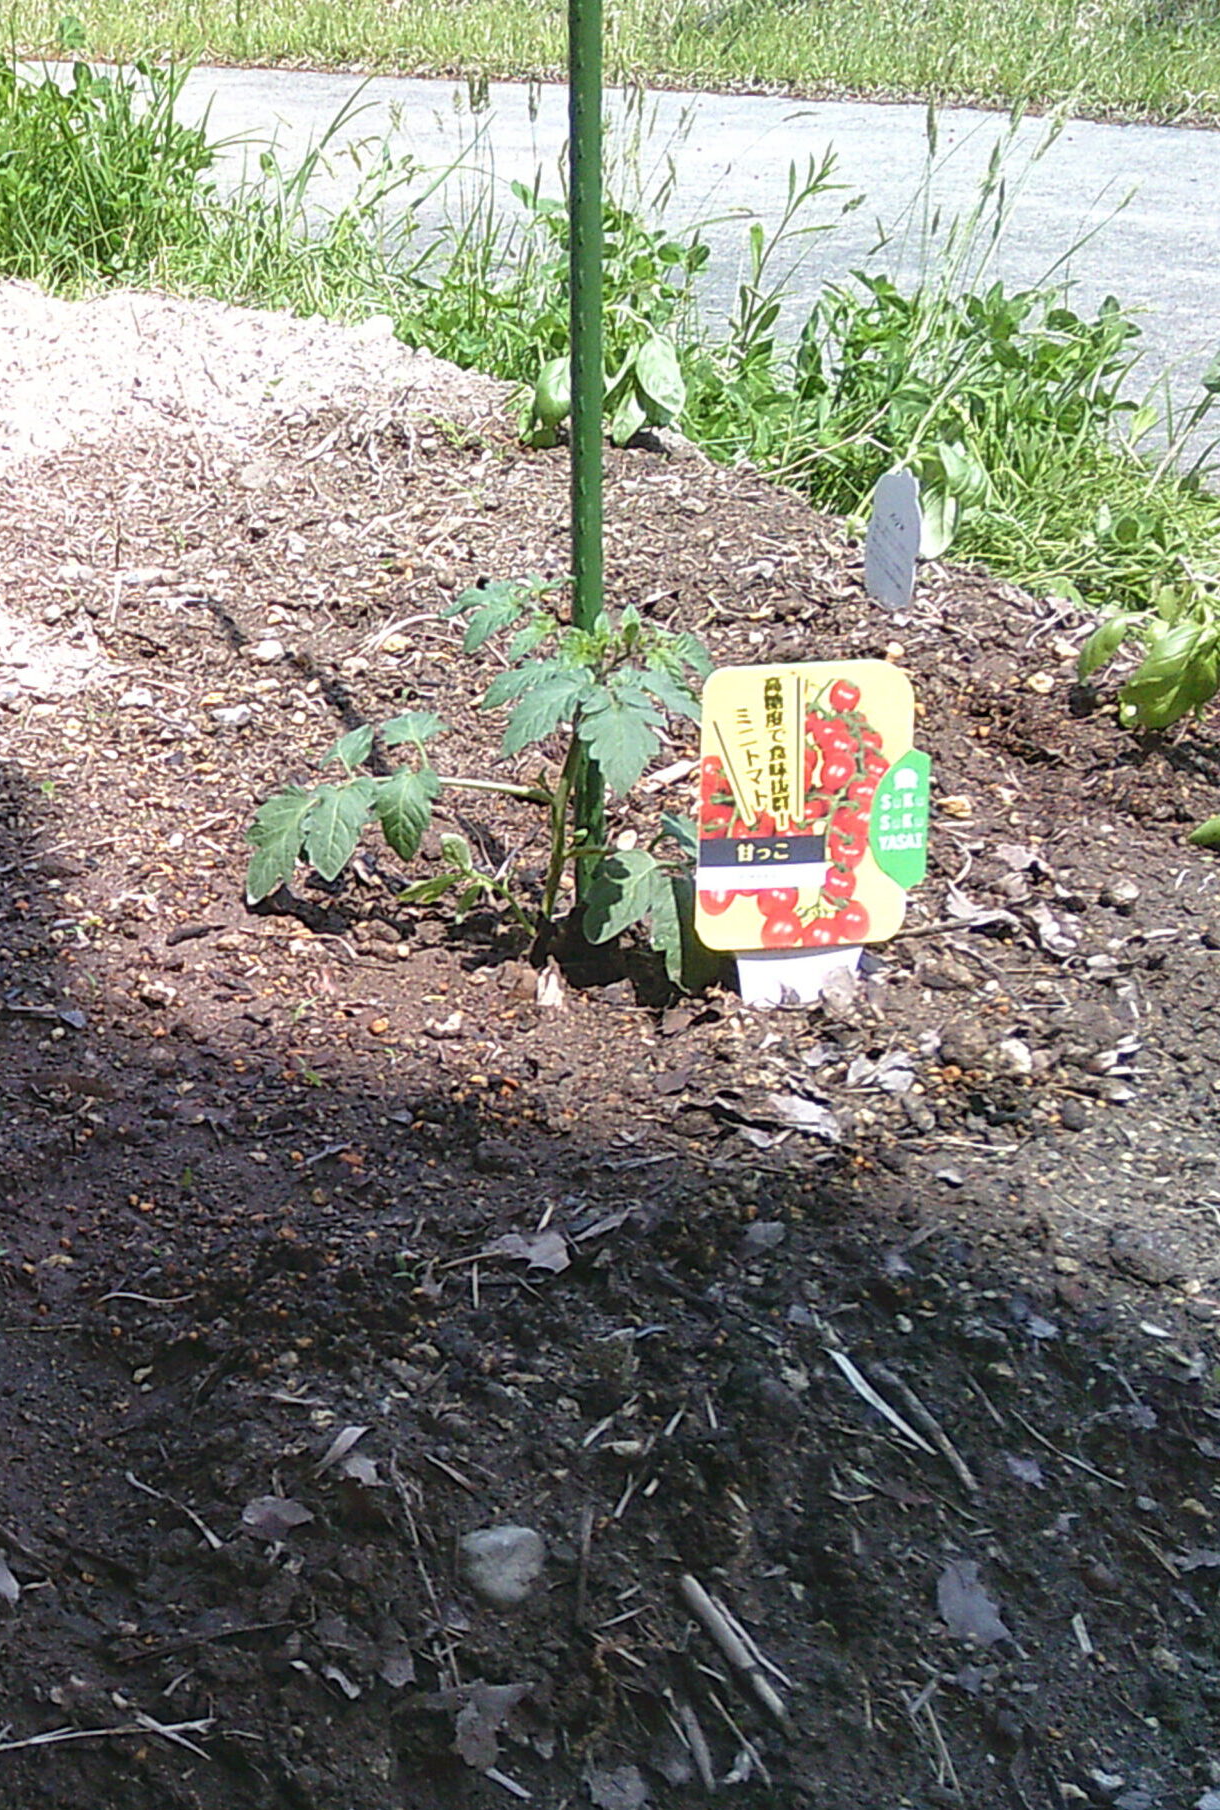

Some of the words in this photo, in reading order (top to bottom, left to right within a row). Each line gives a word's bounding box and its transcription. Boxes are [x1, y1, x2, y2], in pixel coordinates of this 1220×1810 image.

[736, 708, 768, 808] ミニトマト
[878, 832, 923, 851] YASAI
[736, 842, 790, 862] 甘っこ
